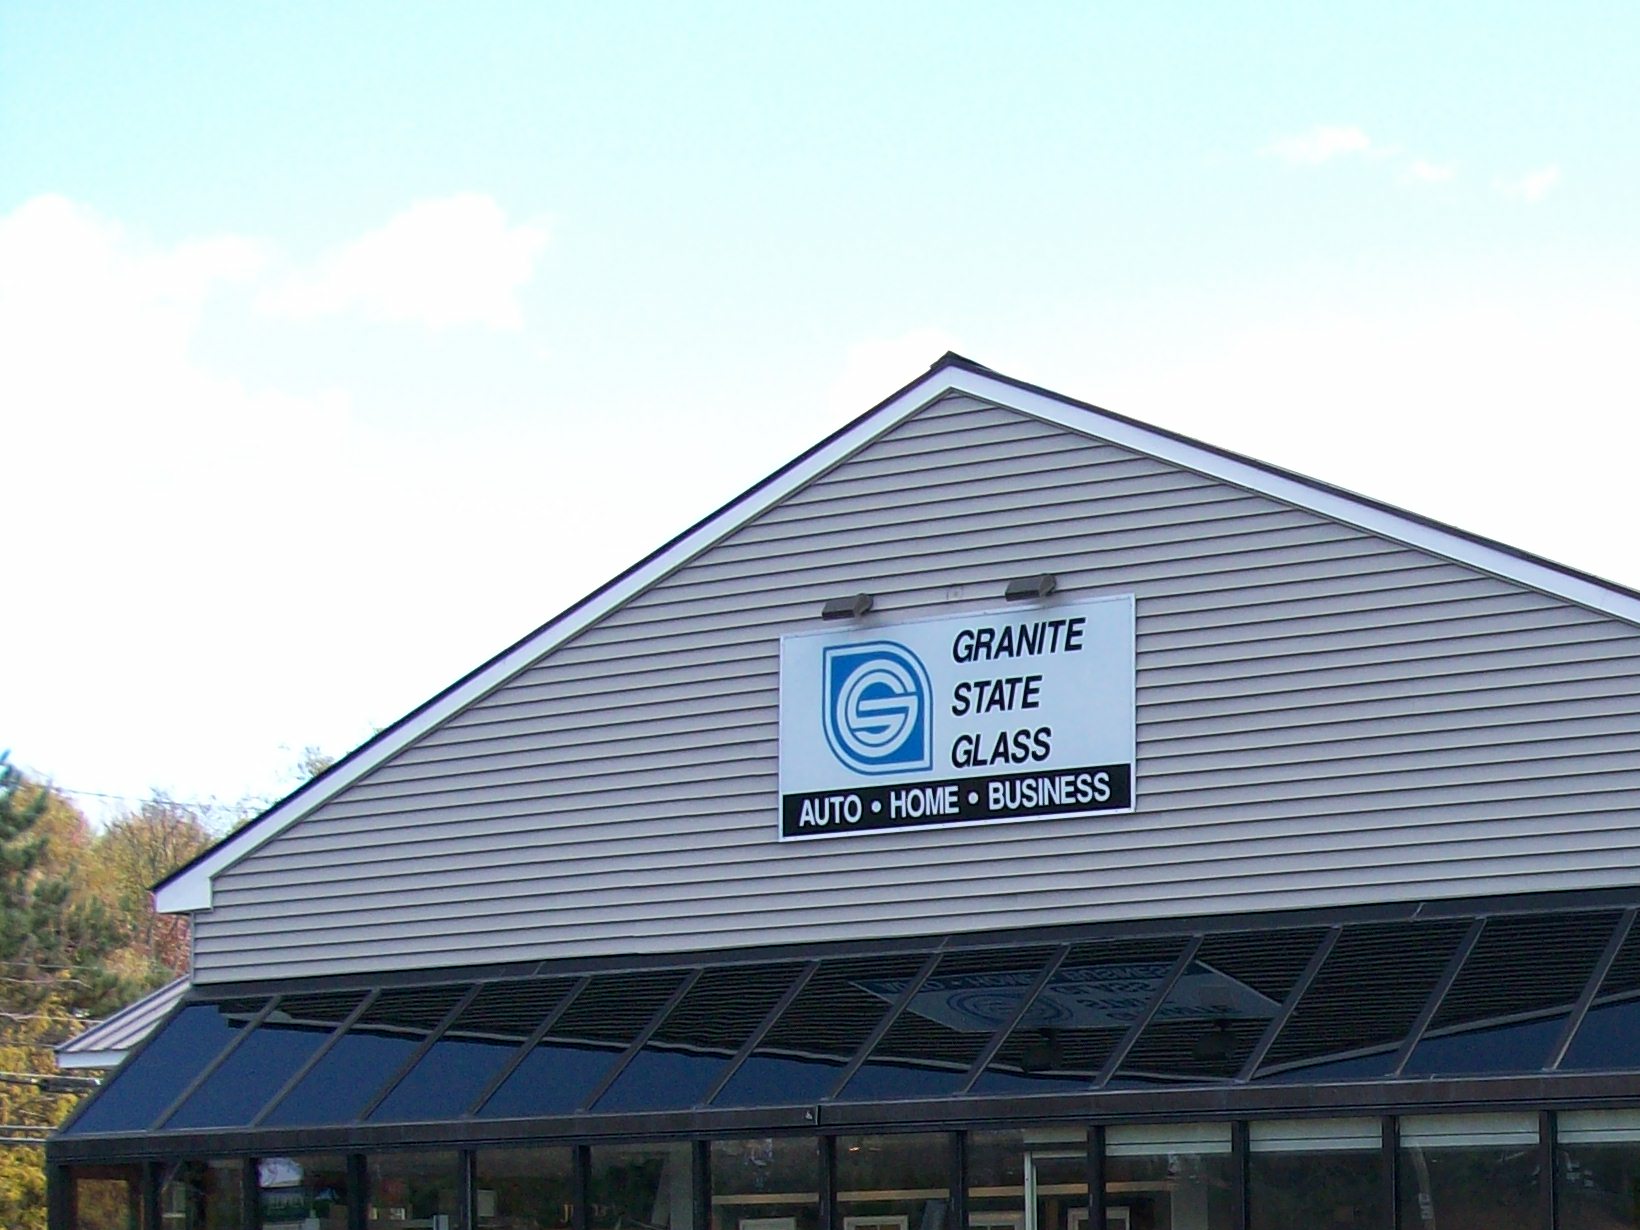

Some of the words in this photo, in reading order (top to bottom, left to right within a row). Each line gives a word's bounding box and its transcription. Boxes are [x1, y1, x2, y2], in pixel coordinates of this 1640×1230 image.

[952, 617, 1086, 663] GRANITE
[951, 675, 1043, 716] STATE
[951, 727, 1052, 769] GLASS
[799, 794, 863, 828] AUTO
[889, 785, 960, 820] HOME
[988, 771, 1111, 811] BUSINESS
